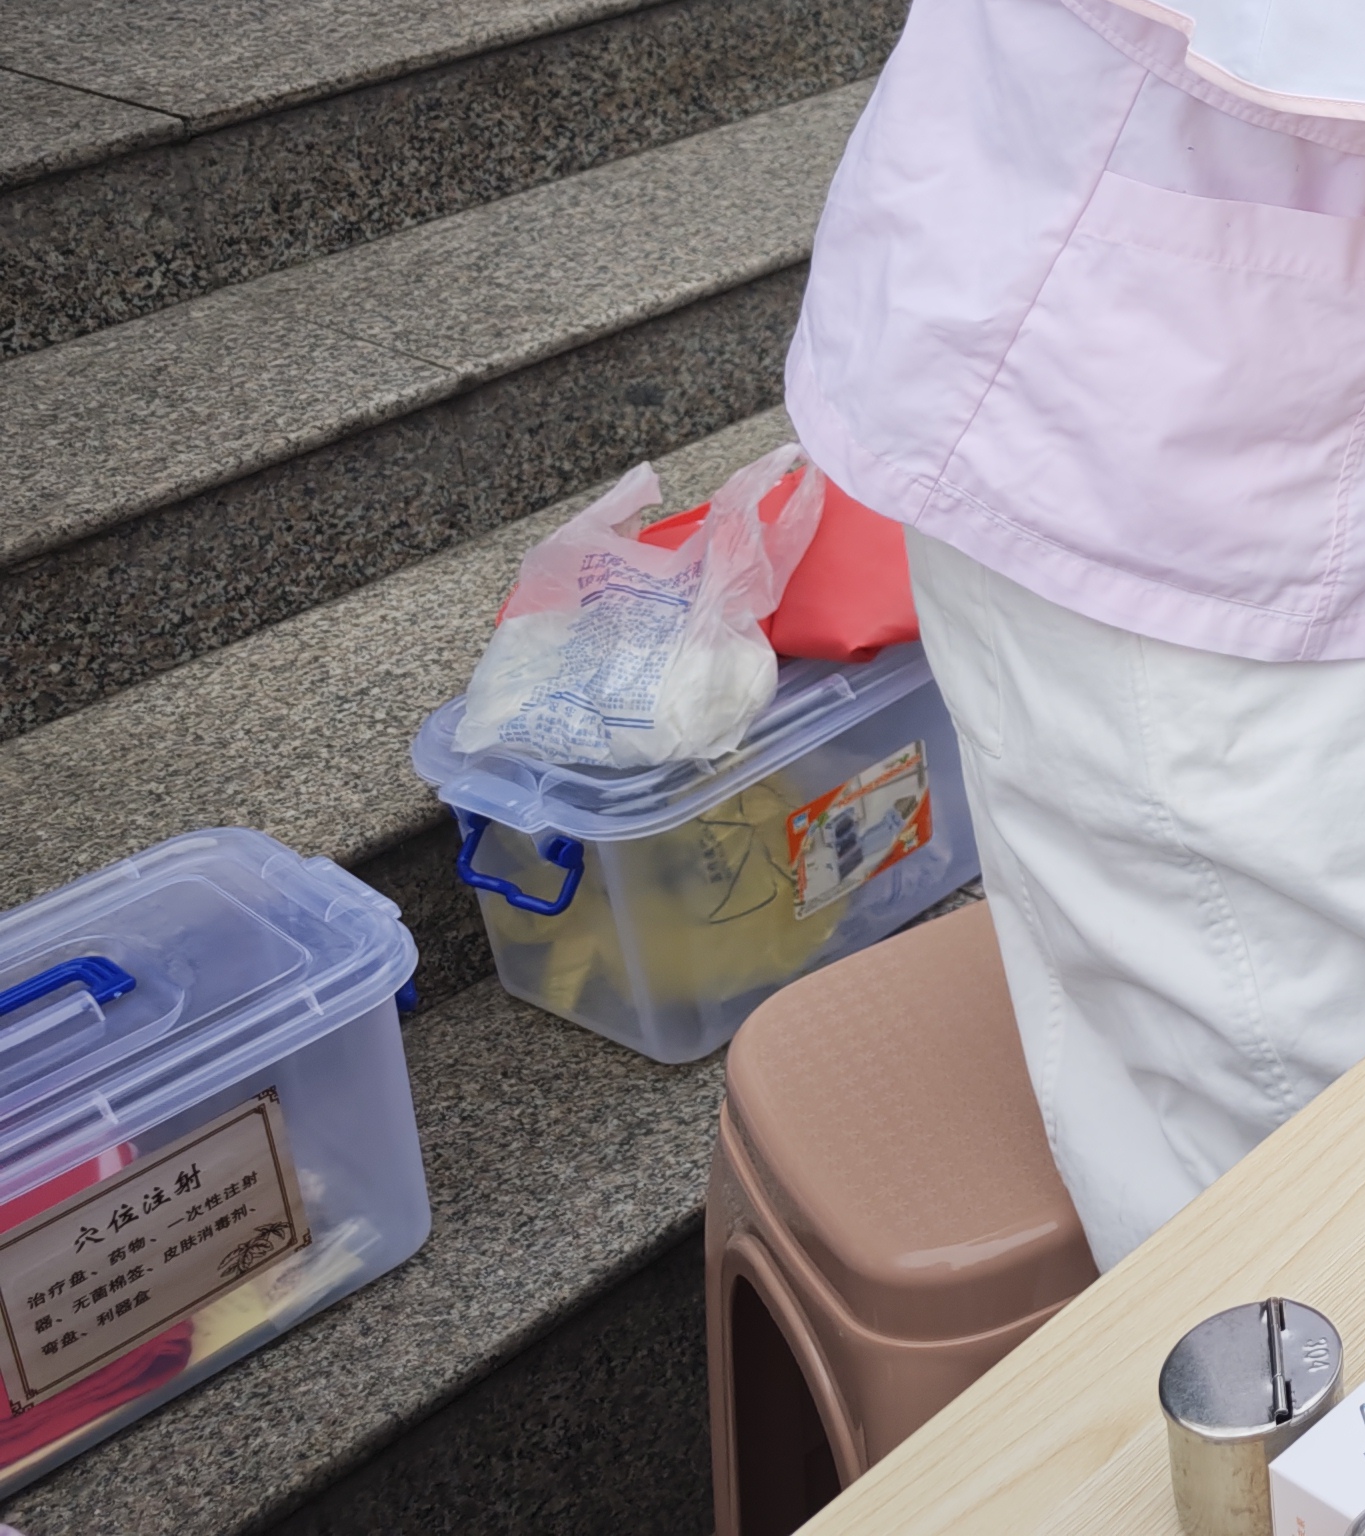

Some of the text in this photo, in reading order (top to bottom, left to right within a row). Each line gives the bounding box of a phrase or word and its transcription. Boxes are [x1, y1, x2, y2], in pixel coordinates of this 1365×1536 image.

[27, 1170, 259, 1310] 治疗盘、药物、一次性注射
[73, 1163, 204, 1253] 穴位注射
[41, 1289, 152, 1357] 弯盘、利器盒
